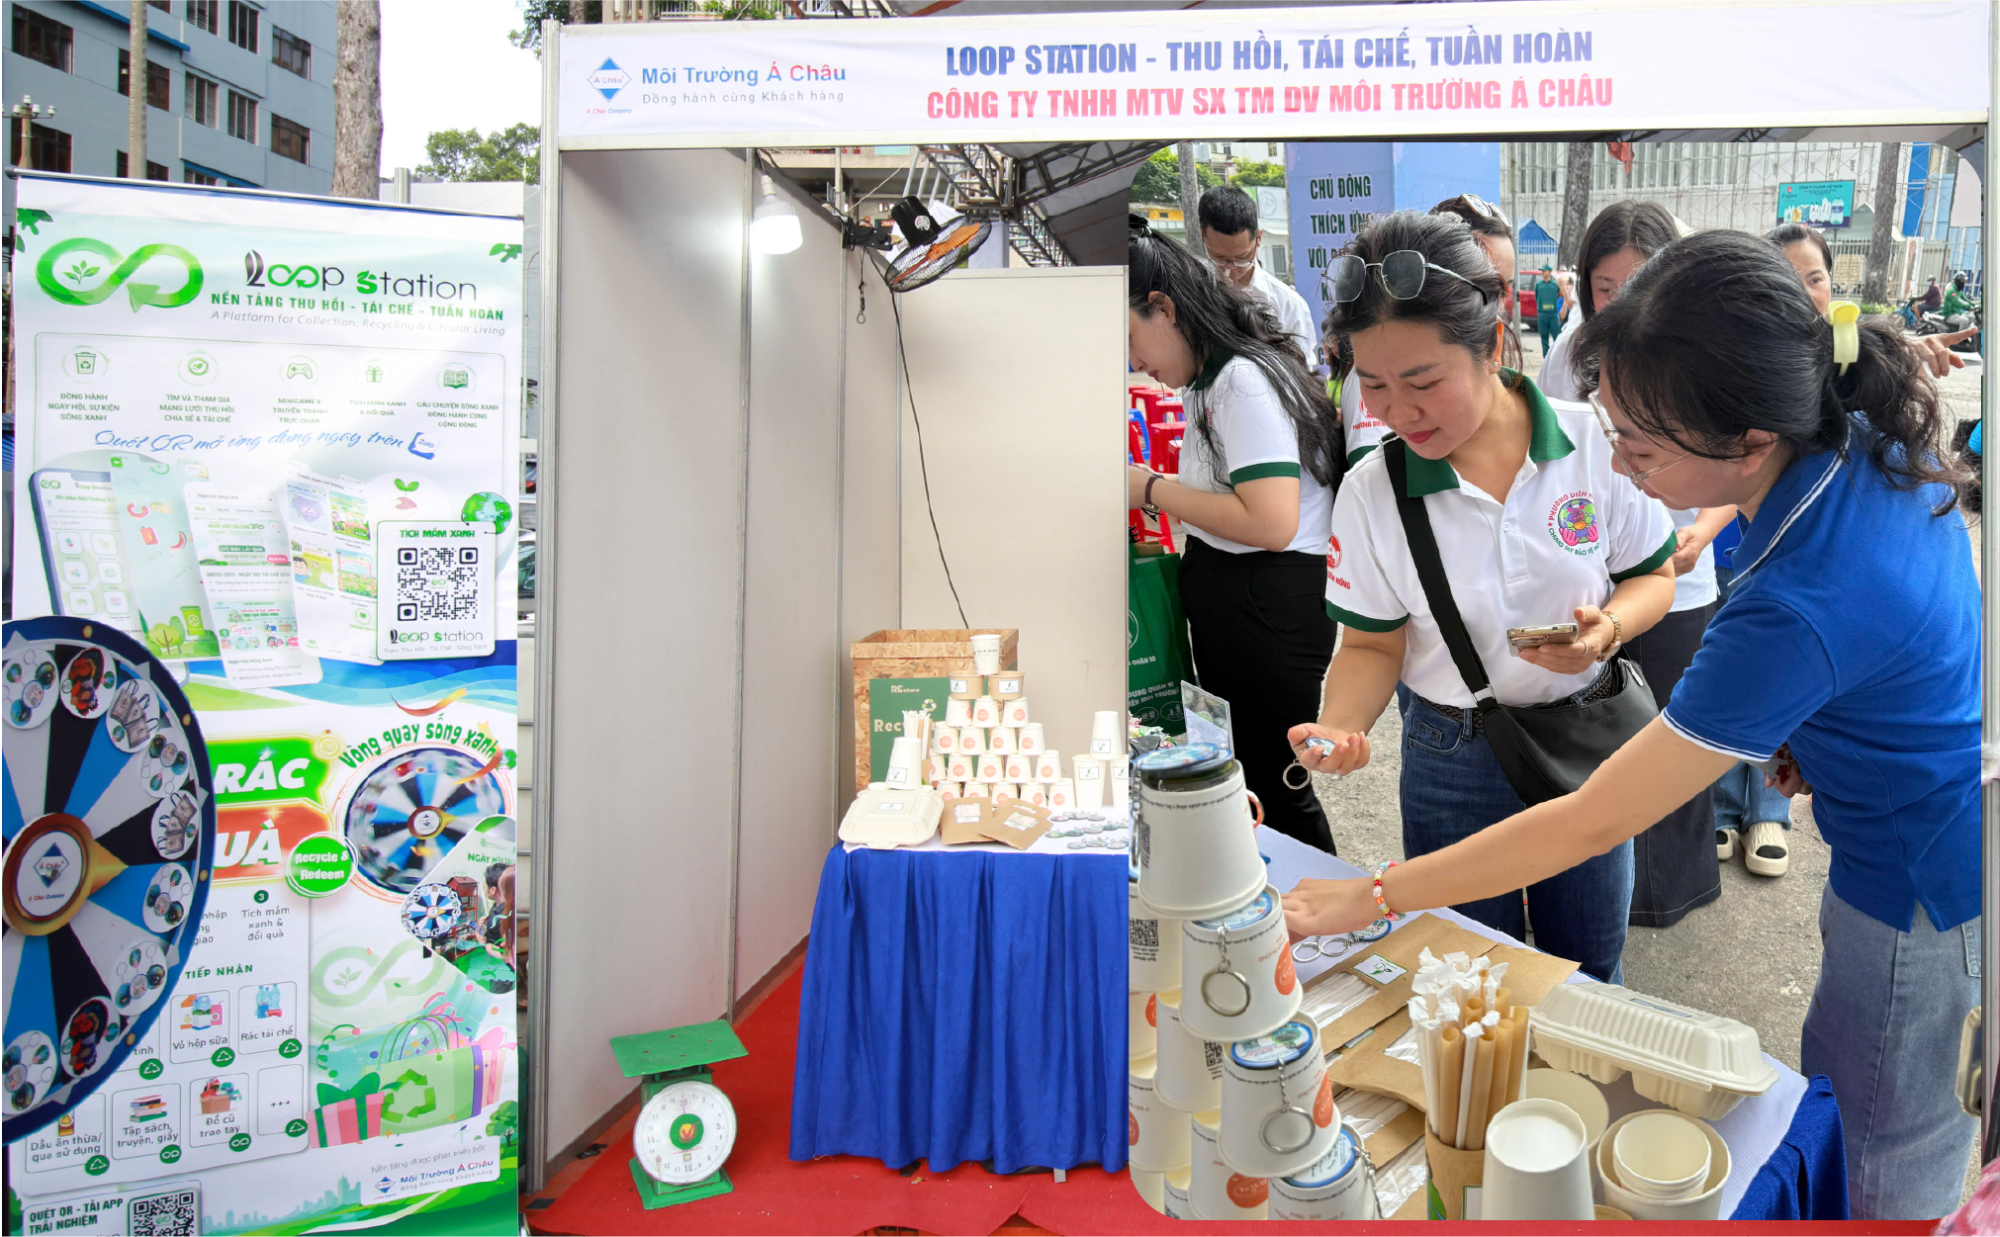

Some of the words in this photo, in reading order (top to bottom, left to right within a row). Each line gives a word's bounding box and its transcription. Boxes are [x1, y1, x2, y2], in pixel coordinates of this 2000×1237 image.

[946, 46, 1015, 76] LOOP
[1026, 43, 1136, 75] STATION
[1166, 41, 1222, 72] THU
[1233, 30, 1288, 72] HỒI,
[1298, 34, 1344, 69] TÁI
[1354, 27, 1416, 69] CHẾ,
[1426, 26, 1502, 66] TUẦN
[1513, 28, 1592, 64] HOÀN
[642, 68, 677, 84] Môi
[683, 67, 759, 86] Trường
[766, 61, 782, 82] Á
[790, 64, 846, 82] Châu
[642, 93, 677, 106] Đồng
[683, 92, 716, 103] hành
[722, 92, 756, 105] cùng
[762, 91, 804, 102] Khách
[810, 91, 844, 103] hàng
[927, 87, 999, 119] CÔNG
[1008, 91, 1038, 118] TY
[1047, 89, 1117, 118] TNHH
[1126, 88, 1184, 116] MTV
[1192, 87, 1226, 115] SX
[1234, 86, 1274, 114] TM
[1284, 86, 1320, 113] DV
[1329, 78, 1381, 112] MÔI
[1390, 77, 1501, 111] TRƯỜNG
[1511, 76, 1529, 109] Á
[1538, 73, 1612, 108] CHÂU
[1310, 173, 1334, 200] CHỦ
[1337, 173, 1372, 202] ĐỘNG
[1310, 210, 1346, 234] THÍCH
[244, 249, 345, 292] Loop
[356, 269, 477, 301] Station
[289, 297, 316, 310] THU
[361, 300, 383, 314] TÁI
[388, 301, 415, 316] CHẾ
[469, 306, 504, 321] HOÀN
[210, 311, 220, 320] A
[222, 311, 274, 324] Platform
[277, 313, 295, 324] for
[297, 314, 359, 328] Collection,
[362, 319, 415, 332] Recycling
[417, 322, 426, 331] &
[428, 322, 471, 334] Circular
[473, 324, 506, 337] Living
[48, 402, 70, 410] NGÀY
[84, 413, 107, 422] XANH
[94, 429, 150, 449] Quét
[150, 434, 194, 452] QR
[193, 434, 226, 450] mở
[317, 432, 362, 448] ngay
[366, 431, 405, 448] trên
[417, 438, 436, 449] Zalo
[399, 529, 419, 538] TÍCH
[422, 527, 447, 538] MẦM
[449, 530, 475, 538] XANH
[434, 630, 483, 642] Station
[338, 737, 382, 769] Vòng
[382, 723, 420, 749] quay
[425, 712, 463, 745] sống
[463, 729, 499, 759] xanh
[213, 751, 311, 795] RÁC
[213, 818, 283, 868] UÀ
[295, 852, 338, 865] Recycle
[340, 850, 349, 861] &
[299, 869, 345, 881] Redeem
[258, 893, 265, 901] 3
[241, 908, 262, 918] Tích
[265, 905, 290, 916] mầm
[248, 919, 273, 929] xanh
[276, 918, 283, 927] &
[266, 929, 284, 941] quà
[185, 965, 211, 980] TIẾP
[216, 964, 254, 979] NHẬN
[240, 1031, 259, 1042] Rác
[261, 1029, 274, 1038] tái
[276, 1025, 294, 1036] chế
[172, 1040, 186, 1050] Vỏ
[188, 1038, 207, 1049] hộp
[209, 1035, 229, 1047] sữa
[205, 1115, 220, 1126] Đồ
[222, 1114, 236, 1124] cũ
[122, 1125, 142, 1136] Tập
[157, 1129, 179, 1144] giấy
[200, 1128, 223, 1138] trao
[225, 1125, 241, 1135] tay
[30, 1139, 53, 1152] Dầu
[55, 1137, 70, 1148] ăn
[31, 1151, 53, 1163] qua
[56, 1146, 71, 1158] sử
[73, 1143, 101, 1156] dụng
[433, 1151, 452, 1163] phát
[400, 1174, 418, 1183] Môi
[420, 1167, 455, 1181] Trường
[467, 1160, 494, 1171] Châu
[29, 1207, 56, 1223] QUÉT
[59, 1204, 74, 1217] QR
[83, 1199, 100, 1213] TẢI
[102, 1198, 124, 1210] APP
[29, 1223, 53, 1236] TRẢI
[56, 1214, 98, 1231] NGHIỆM
